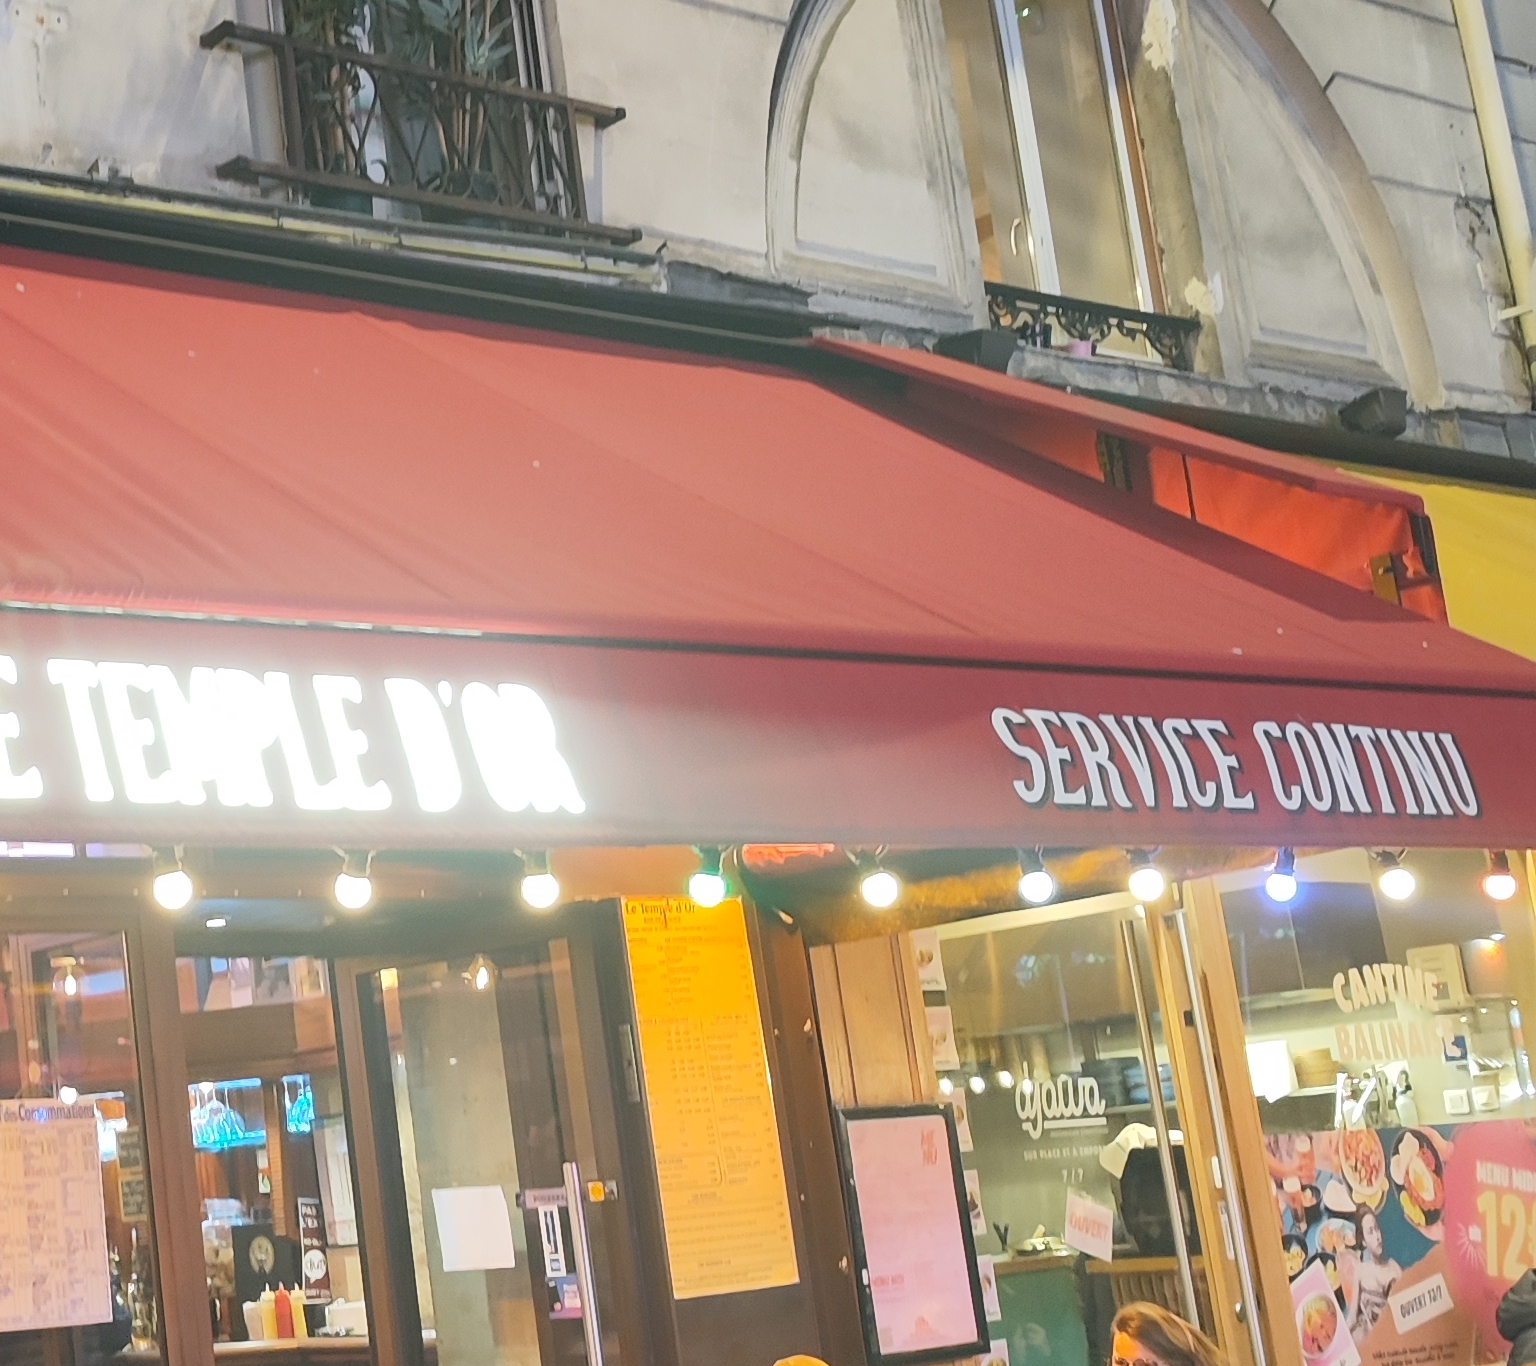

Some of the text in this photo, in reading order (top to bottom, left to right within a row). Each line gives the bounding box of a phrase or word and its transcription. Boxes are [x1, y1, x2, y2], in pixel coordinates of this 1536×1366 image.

[47, 657, 392, 811] TEMPLE
[385, 677, 586, 814] D'OR
[991, 707, 1481, 819] SERVICE CONTINU
[625, 901, 637, 915] Le
[1333, 963, 1440, 1014] CANTINE
[1023, 1148, 1038, 1161] SUR
[1039, 1147, 1061, 1160] PLACE
[1476, 1159, 1510, 1189] MENU
[1069, 1212, 1109, 1243] OUVERT
[1400, 1291, 1427, 1319] OUVERT
